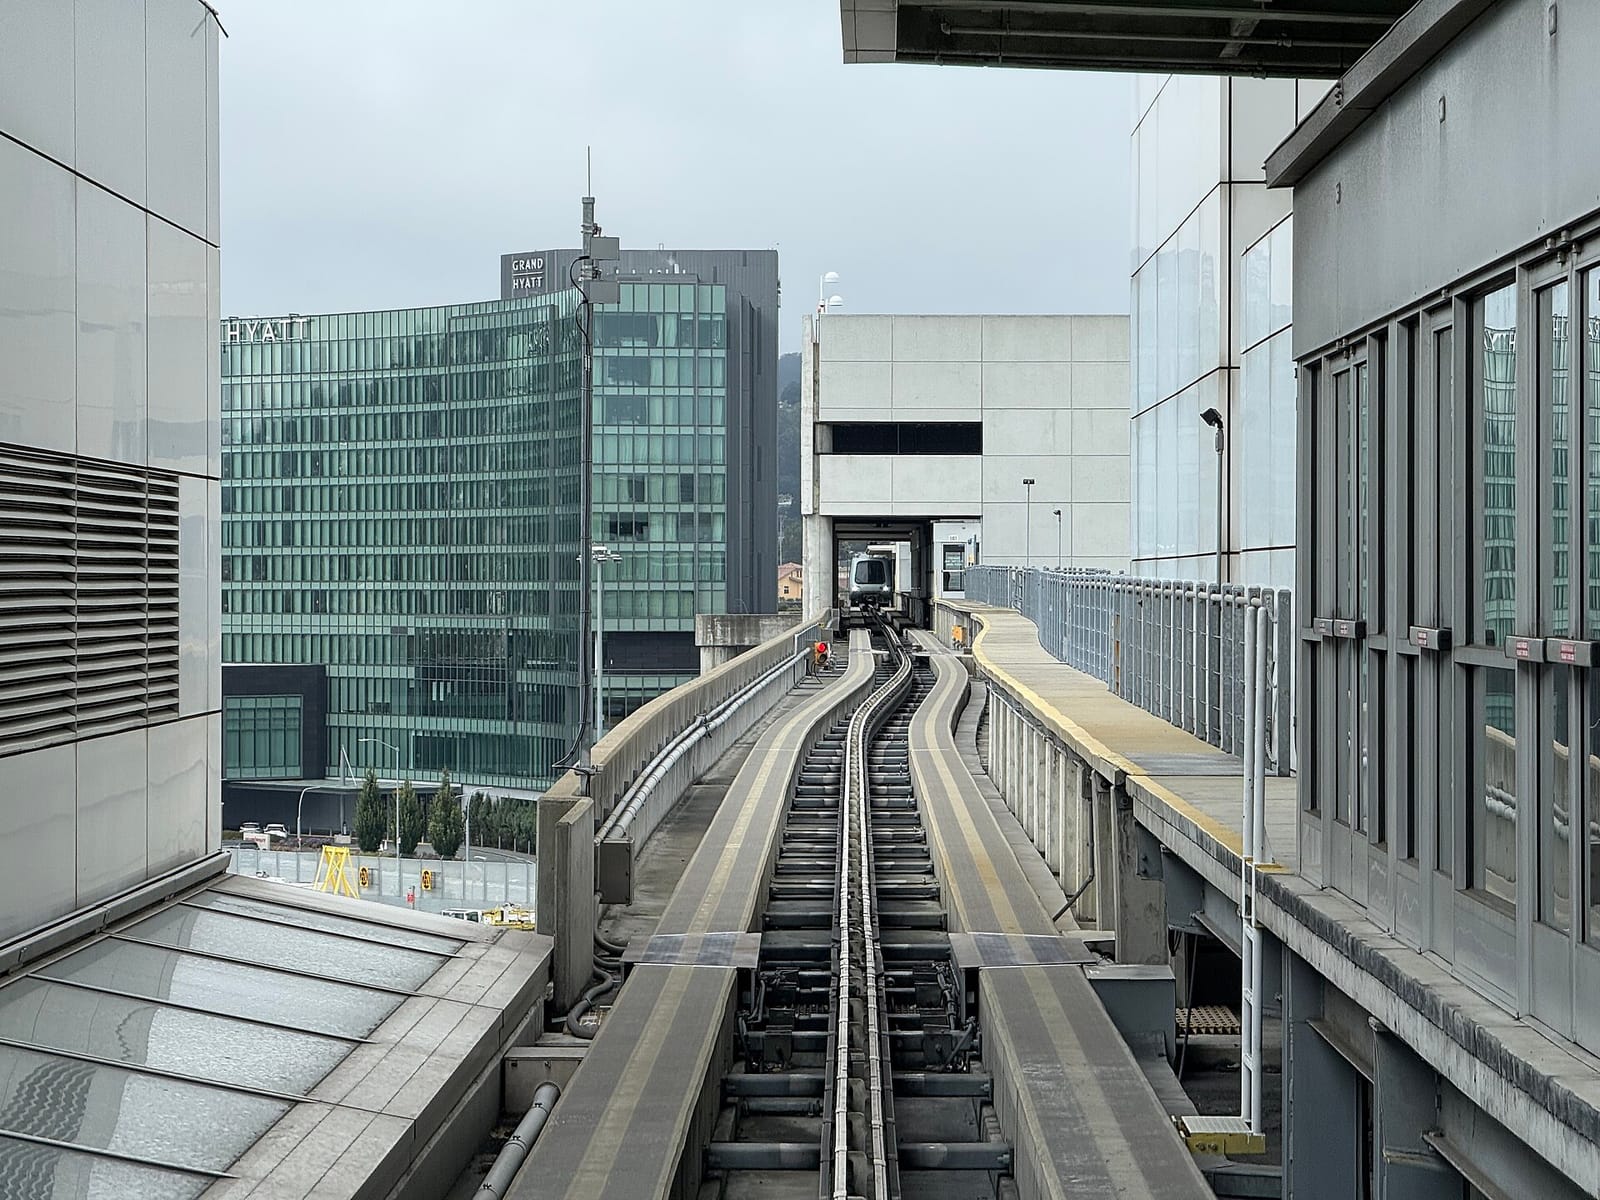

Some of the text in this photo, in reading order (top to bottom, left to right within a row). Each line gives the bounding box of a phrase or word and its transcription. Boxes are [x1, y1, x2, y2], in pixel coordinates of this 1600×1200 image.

[512, 258, 543, 271] GRAND
[512, 276, 543, 289] HYATT
[227, 318, 308, 342] HYATT
